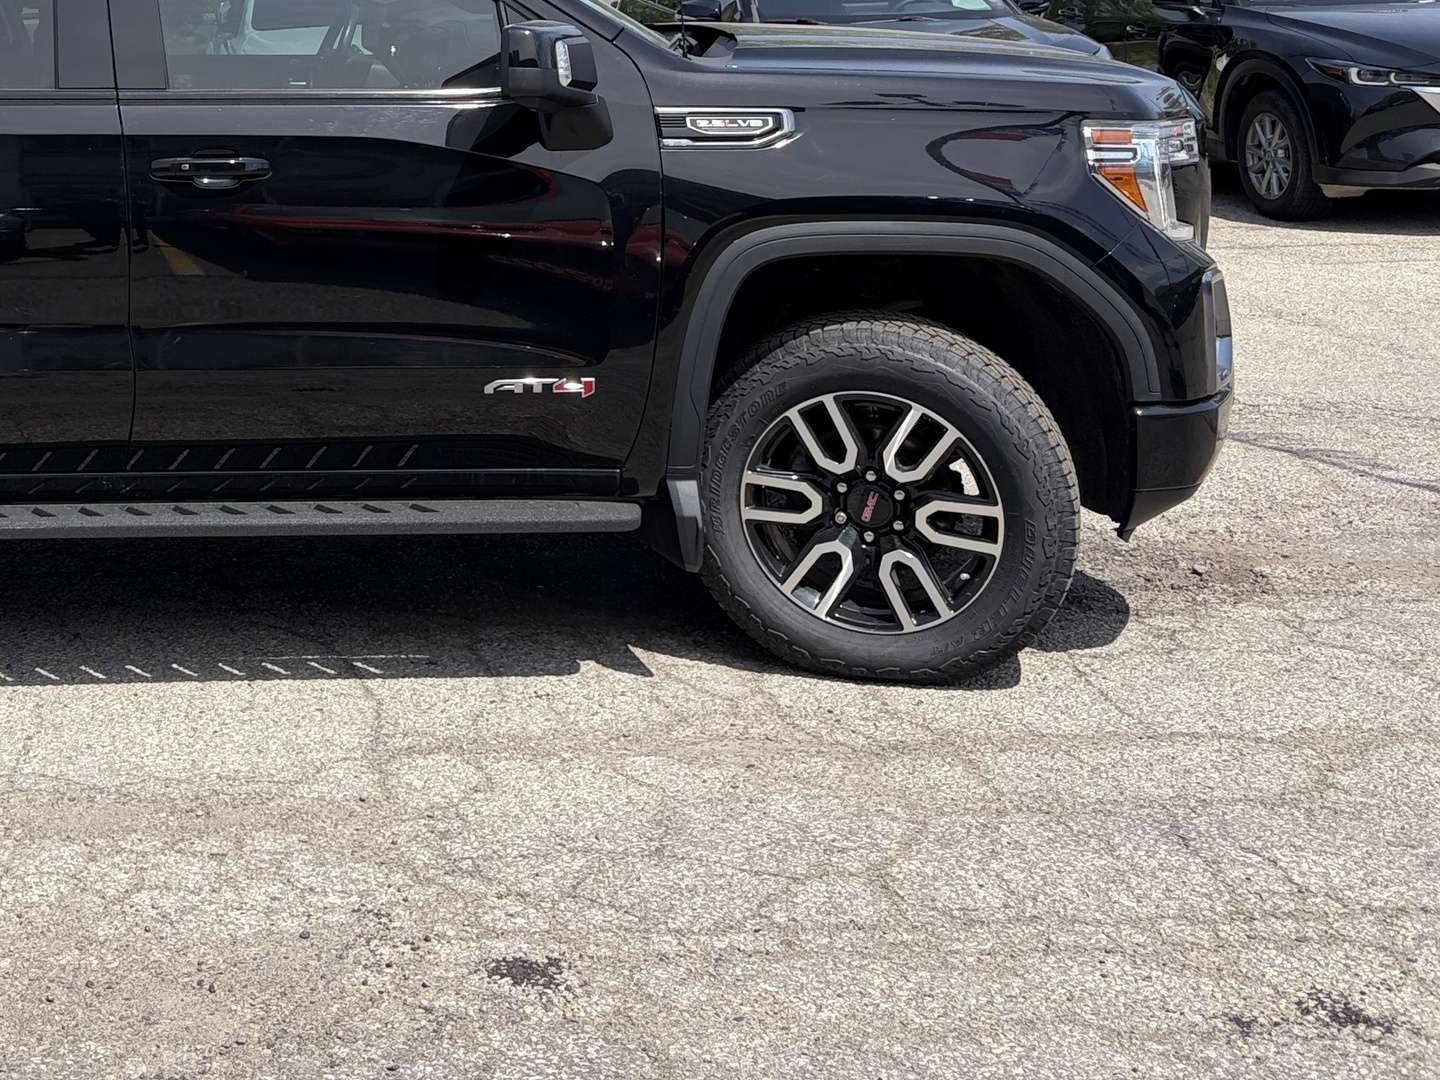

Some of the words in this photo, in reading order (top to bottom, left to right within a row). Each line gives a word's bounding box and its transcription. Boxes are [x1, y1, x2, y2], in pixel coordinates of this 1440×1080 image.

[484, 378, 596, 398] AT4
[712, 381, 789, 536] BRIDGESTONE
[861, 491, 879, 522] GMC
